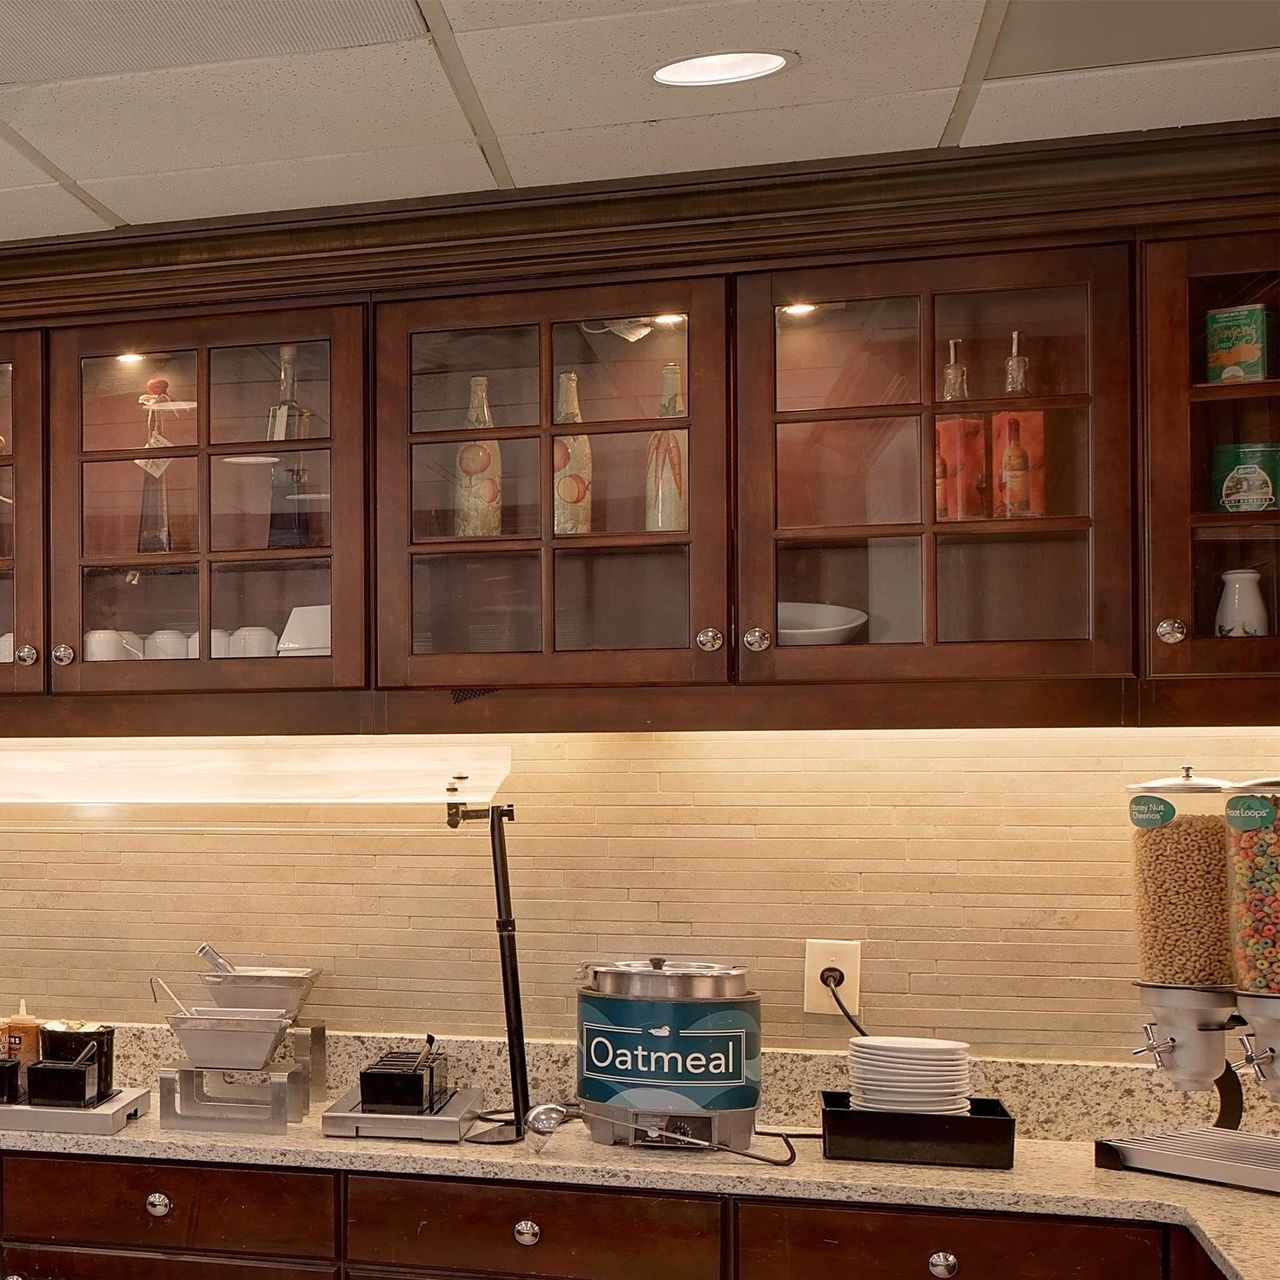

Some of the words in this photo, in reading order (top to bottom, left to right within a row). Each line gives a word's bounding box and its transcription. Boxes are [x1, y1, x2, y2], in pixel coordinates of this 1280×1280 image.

[1149, 803, 1165, 811] Nut
[1241, 809, 1267, 817] Loops
[590, 1036, 734, 1074] Oatmeal
